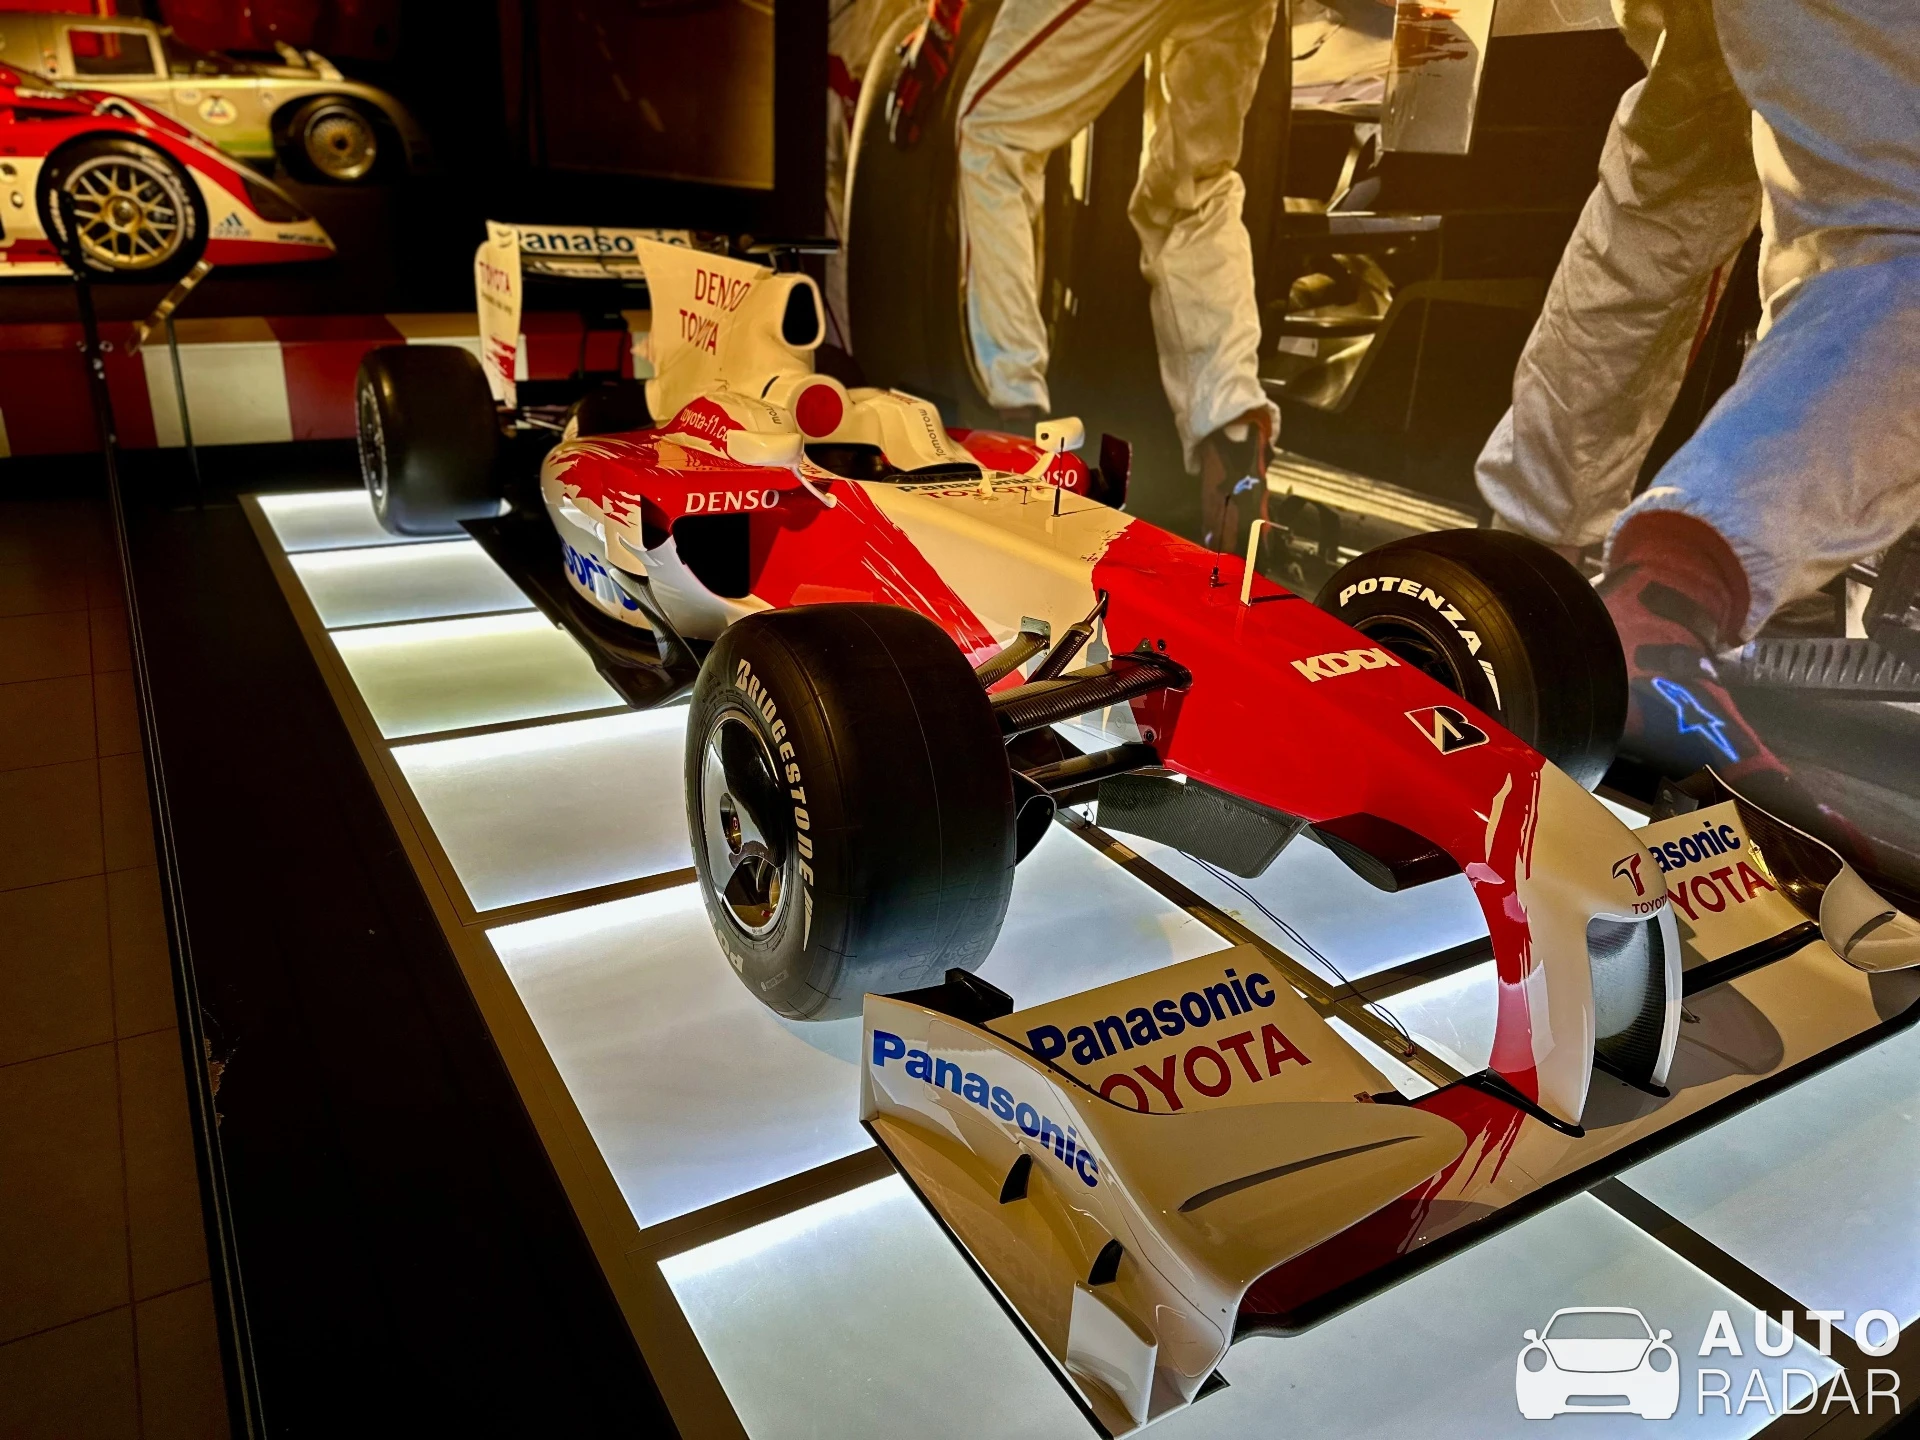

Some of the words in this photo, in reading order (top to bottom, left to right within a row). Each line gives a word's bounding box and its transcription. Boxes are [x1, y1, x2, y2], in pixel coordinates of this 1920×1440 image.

[695, 268, 752, 312] DENSO
[679, 307, 719, 356] TOYOTA
[917, 408, 946, 458] Tomorrow
[685, 489, 780, 513] DENSO
[1339, 576, 1482, 657] POTENZA
[1290, 647, 1402, 683] KDDI
[734, 658, 814, 886] BRIDGESTONE
[1647, 820, 1741, 873] asonic
[1667, 861, 1778, 921] YOTA
[1026, 967, 1277, 1066] Panasonic
[1100, 1023, 1312, 1113] OYOTA
[872, 1029, 1100, 1188] Panasonic
